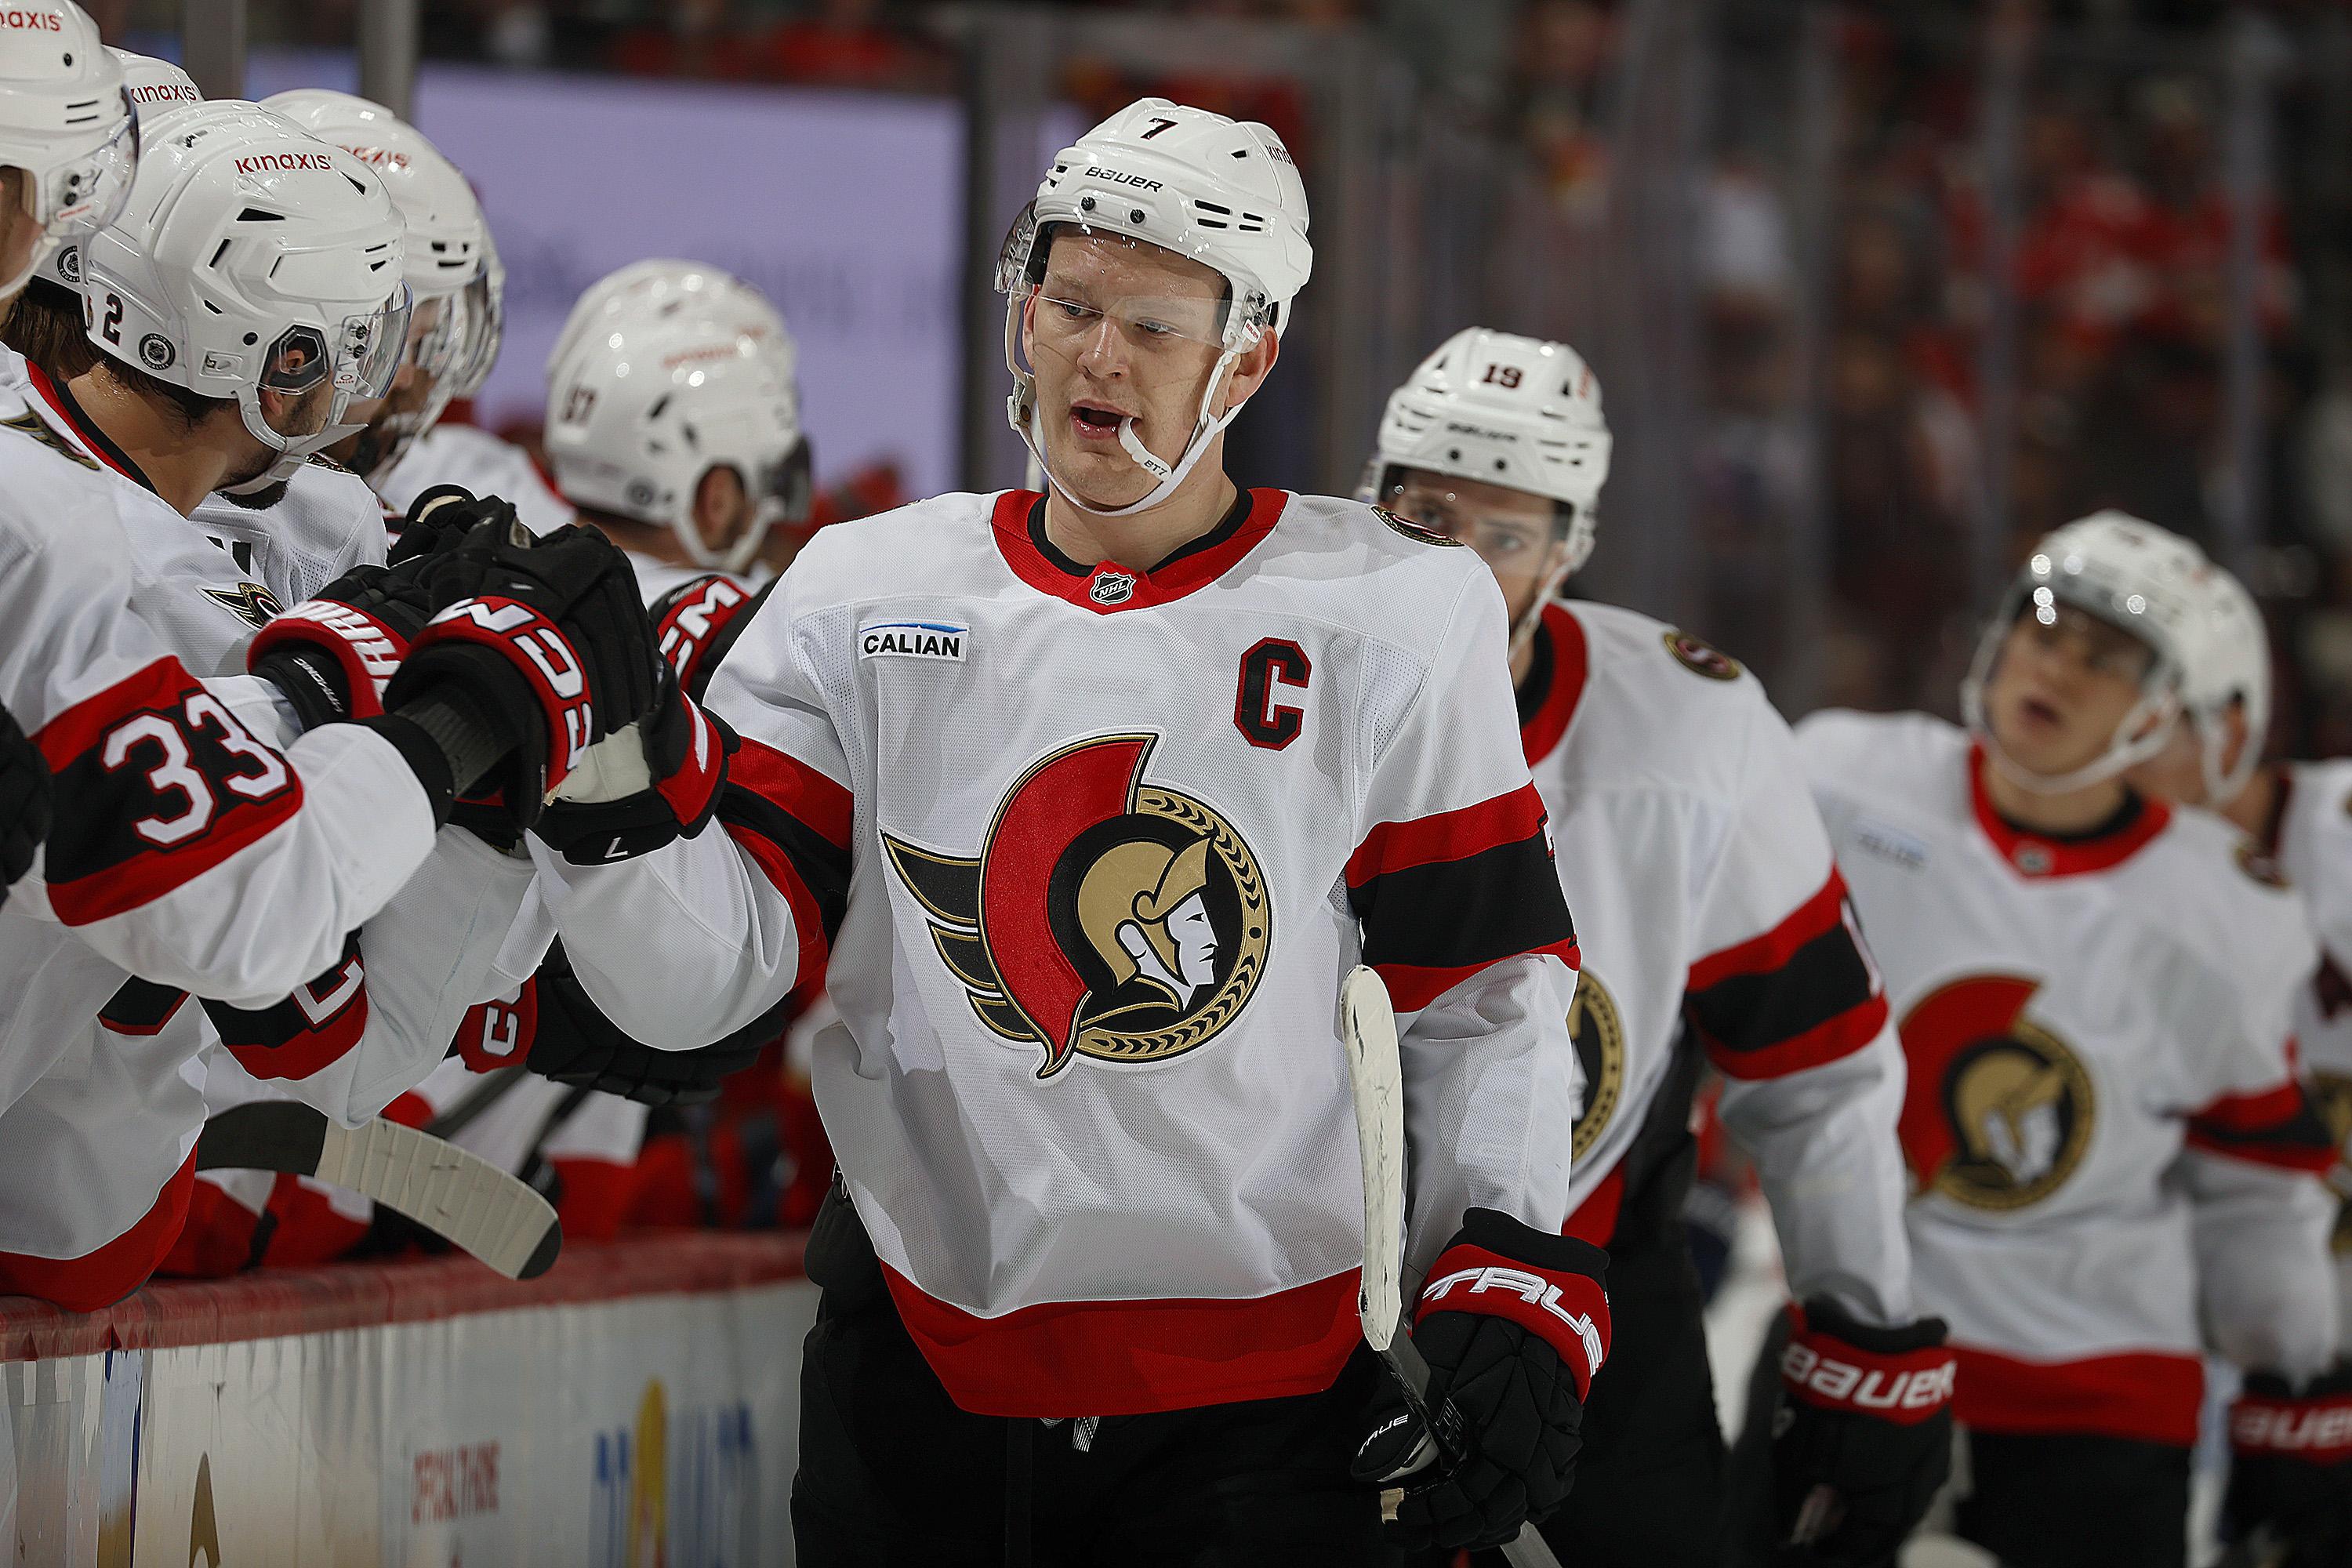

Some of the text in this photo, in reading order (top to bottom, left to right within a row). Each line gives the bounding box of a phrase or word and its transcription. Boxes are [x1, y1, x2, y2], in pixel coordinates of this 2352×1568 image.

[1140, 117, 1179, 140] 7
[1084, 165, 1164, 193] BAUER
[102, 292, 124, 347] 2
[1482, 363, 1524, 390] 19
[1144, 459, 1167, 476] BT7
[1098, 582, 1127, 598] NHL
[863, 633, 960, 658] CALIAN
[1233, 637, 1312, 751] C
[100, 691, 292, 847] 33
